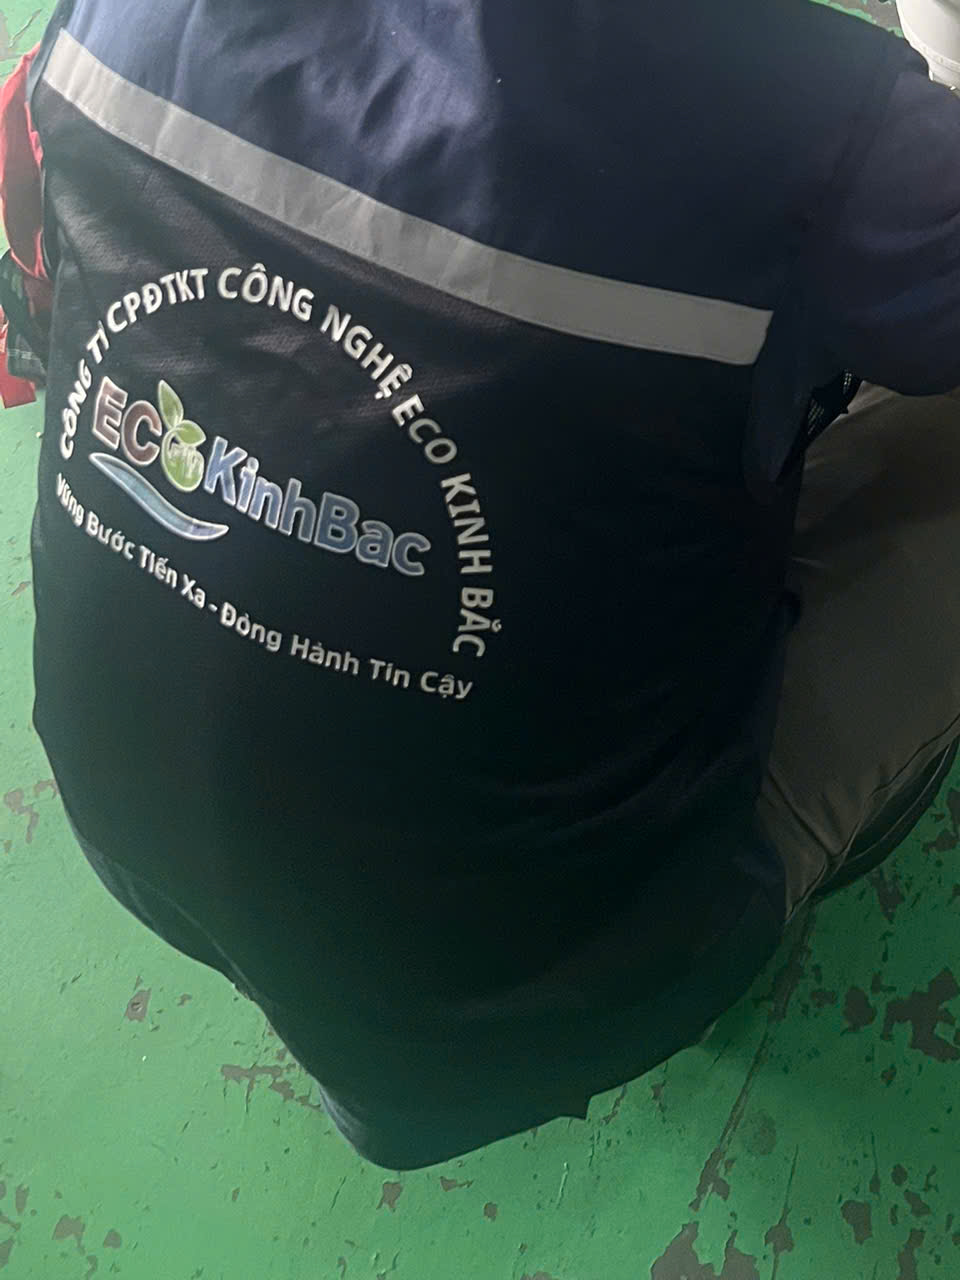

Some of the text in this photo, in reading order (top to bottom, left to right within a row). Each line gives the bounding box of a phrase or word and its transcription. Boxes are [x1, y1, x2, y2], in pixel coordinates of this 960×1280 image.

[106, 268, 208, 333] CPĐTKT
[216, 262, 315, 321] CÔNG
[319, 304, 414, 401] NGHỆ
[60, 358, 92, 460] CÔNG
[391, 393, 458, 464] ECO
[440, 471, 494, 576] KINH
[85, 509, 135, 561] Bước
[138, 544, 178, 590] Tiến
[180, 573, 206, 608] Xa
[368, 658, 411, 689] Tin
[419, 670, 473, 700] Cậy
[452, 586, 502, 657] BẮC
